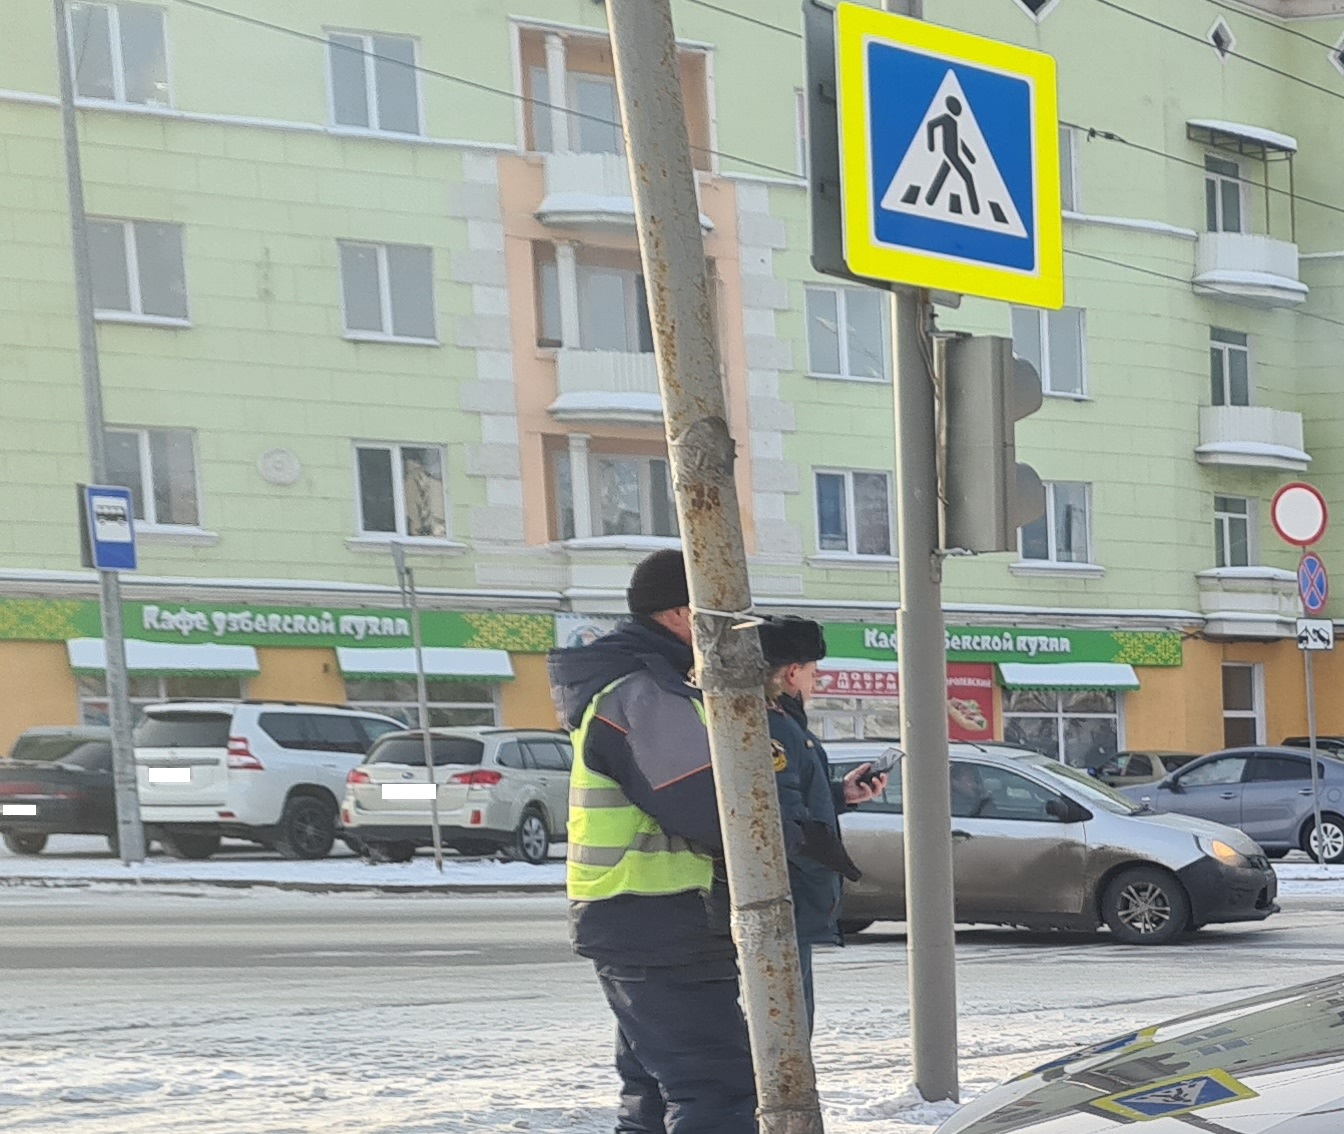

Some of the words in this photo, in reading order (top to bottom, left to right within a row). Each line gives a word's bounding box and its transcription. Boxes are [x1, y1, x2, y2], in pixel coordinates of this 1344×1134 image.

[142, 605, 209, 637] Кафе
[210, 610, 337, 637] узбекской
[338, 613, 411, 641] кухни
